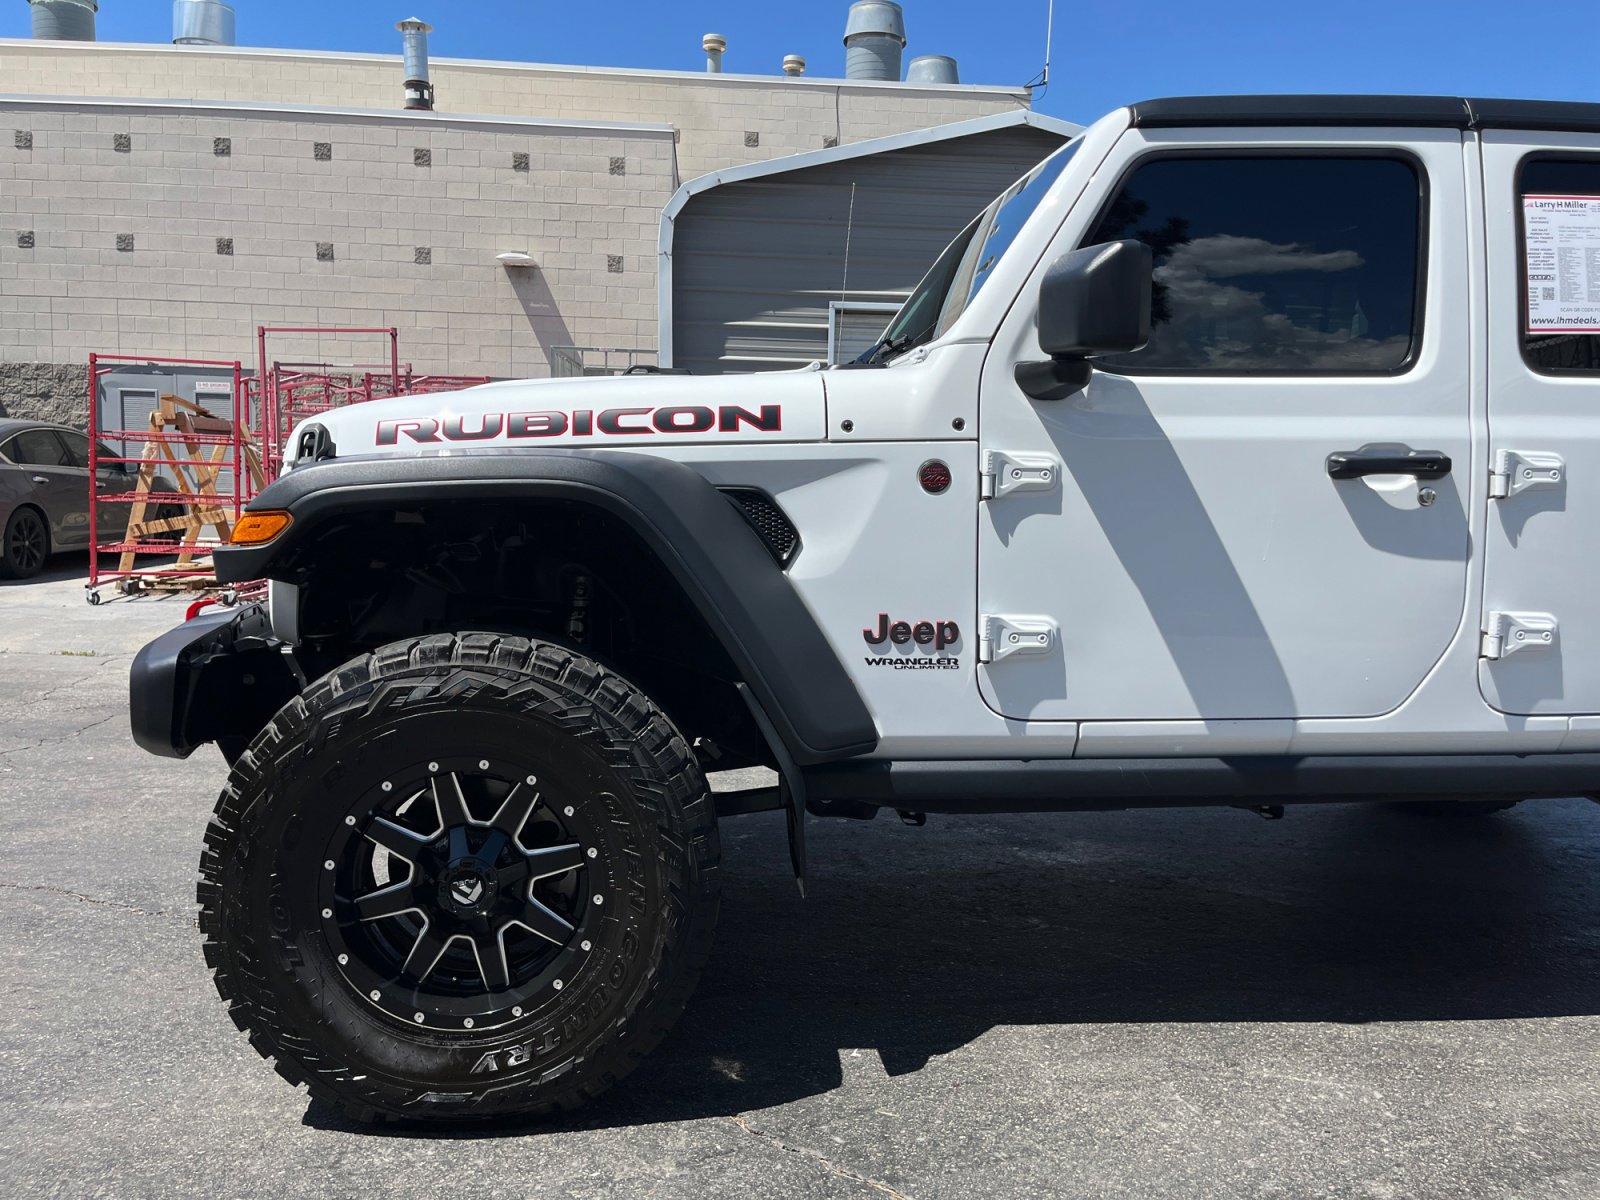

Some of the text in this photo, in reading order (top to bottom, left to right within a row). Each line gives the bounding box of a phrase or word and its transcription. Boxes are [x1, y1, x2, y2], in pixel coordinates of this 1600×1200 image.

[375, 404, 782, 446] RUBICON
[863, 612, 960, 650] Jeep
[864, 658, 958, 666] WRANGLER
